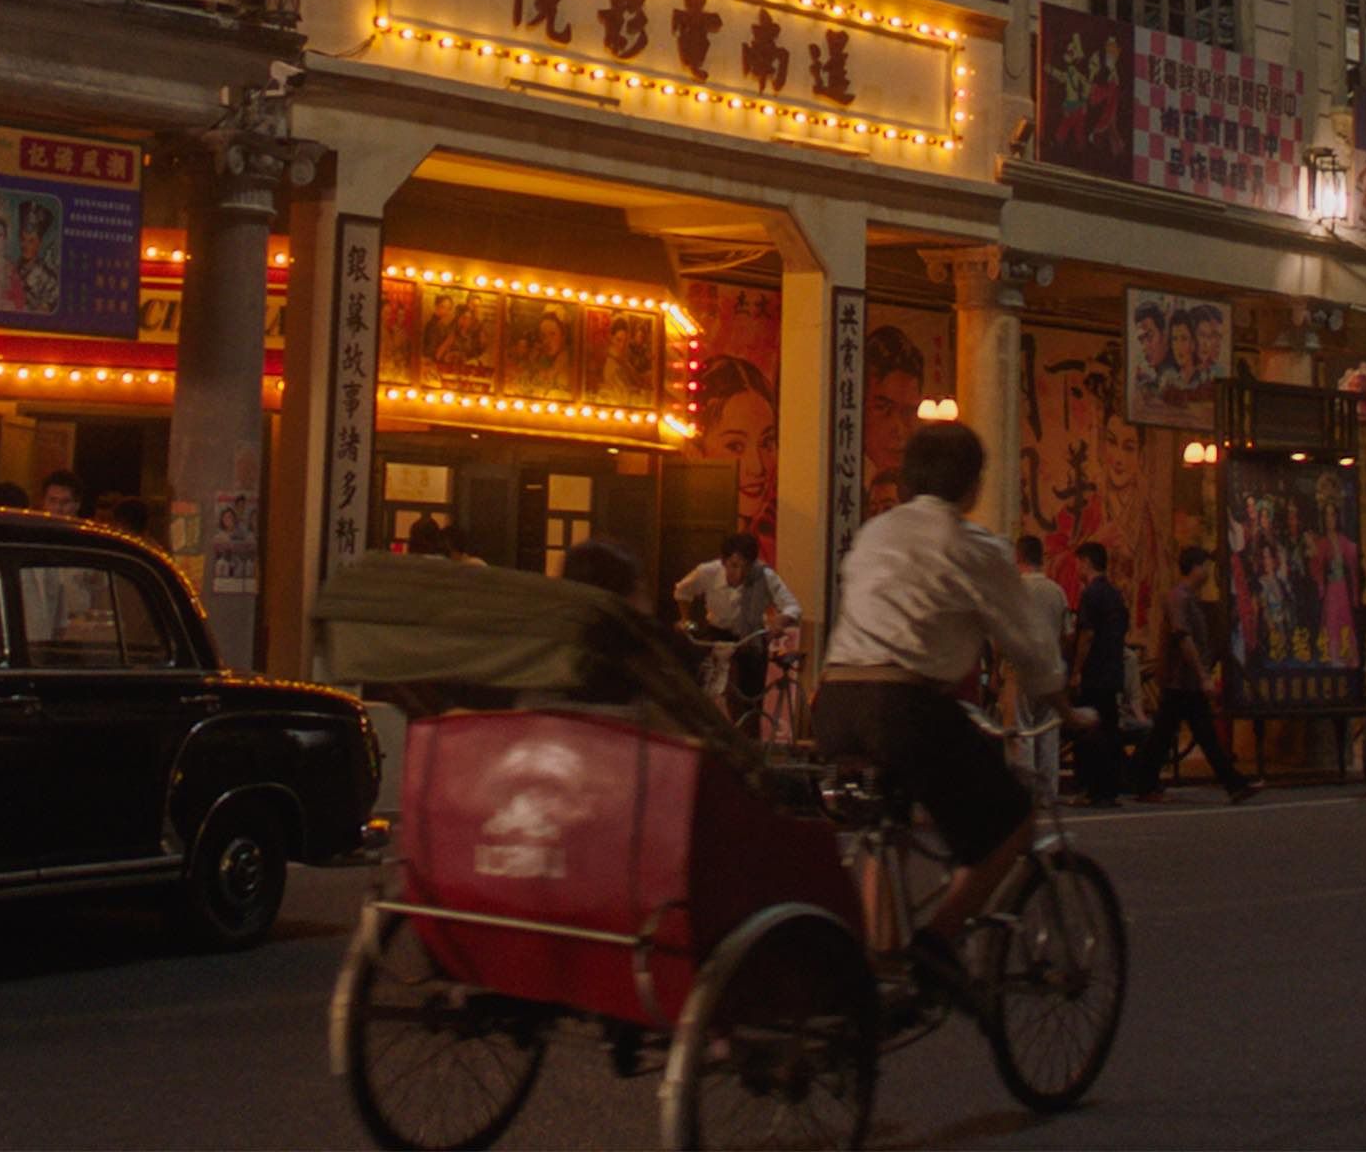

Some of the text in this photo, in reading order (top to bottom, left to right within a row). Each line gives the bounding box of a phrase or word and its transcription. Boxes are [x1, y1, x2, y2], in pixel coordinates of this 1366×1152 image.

[335, 244, 372, 560] 銀幕故事諸多精
